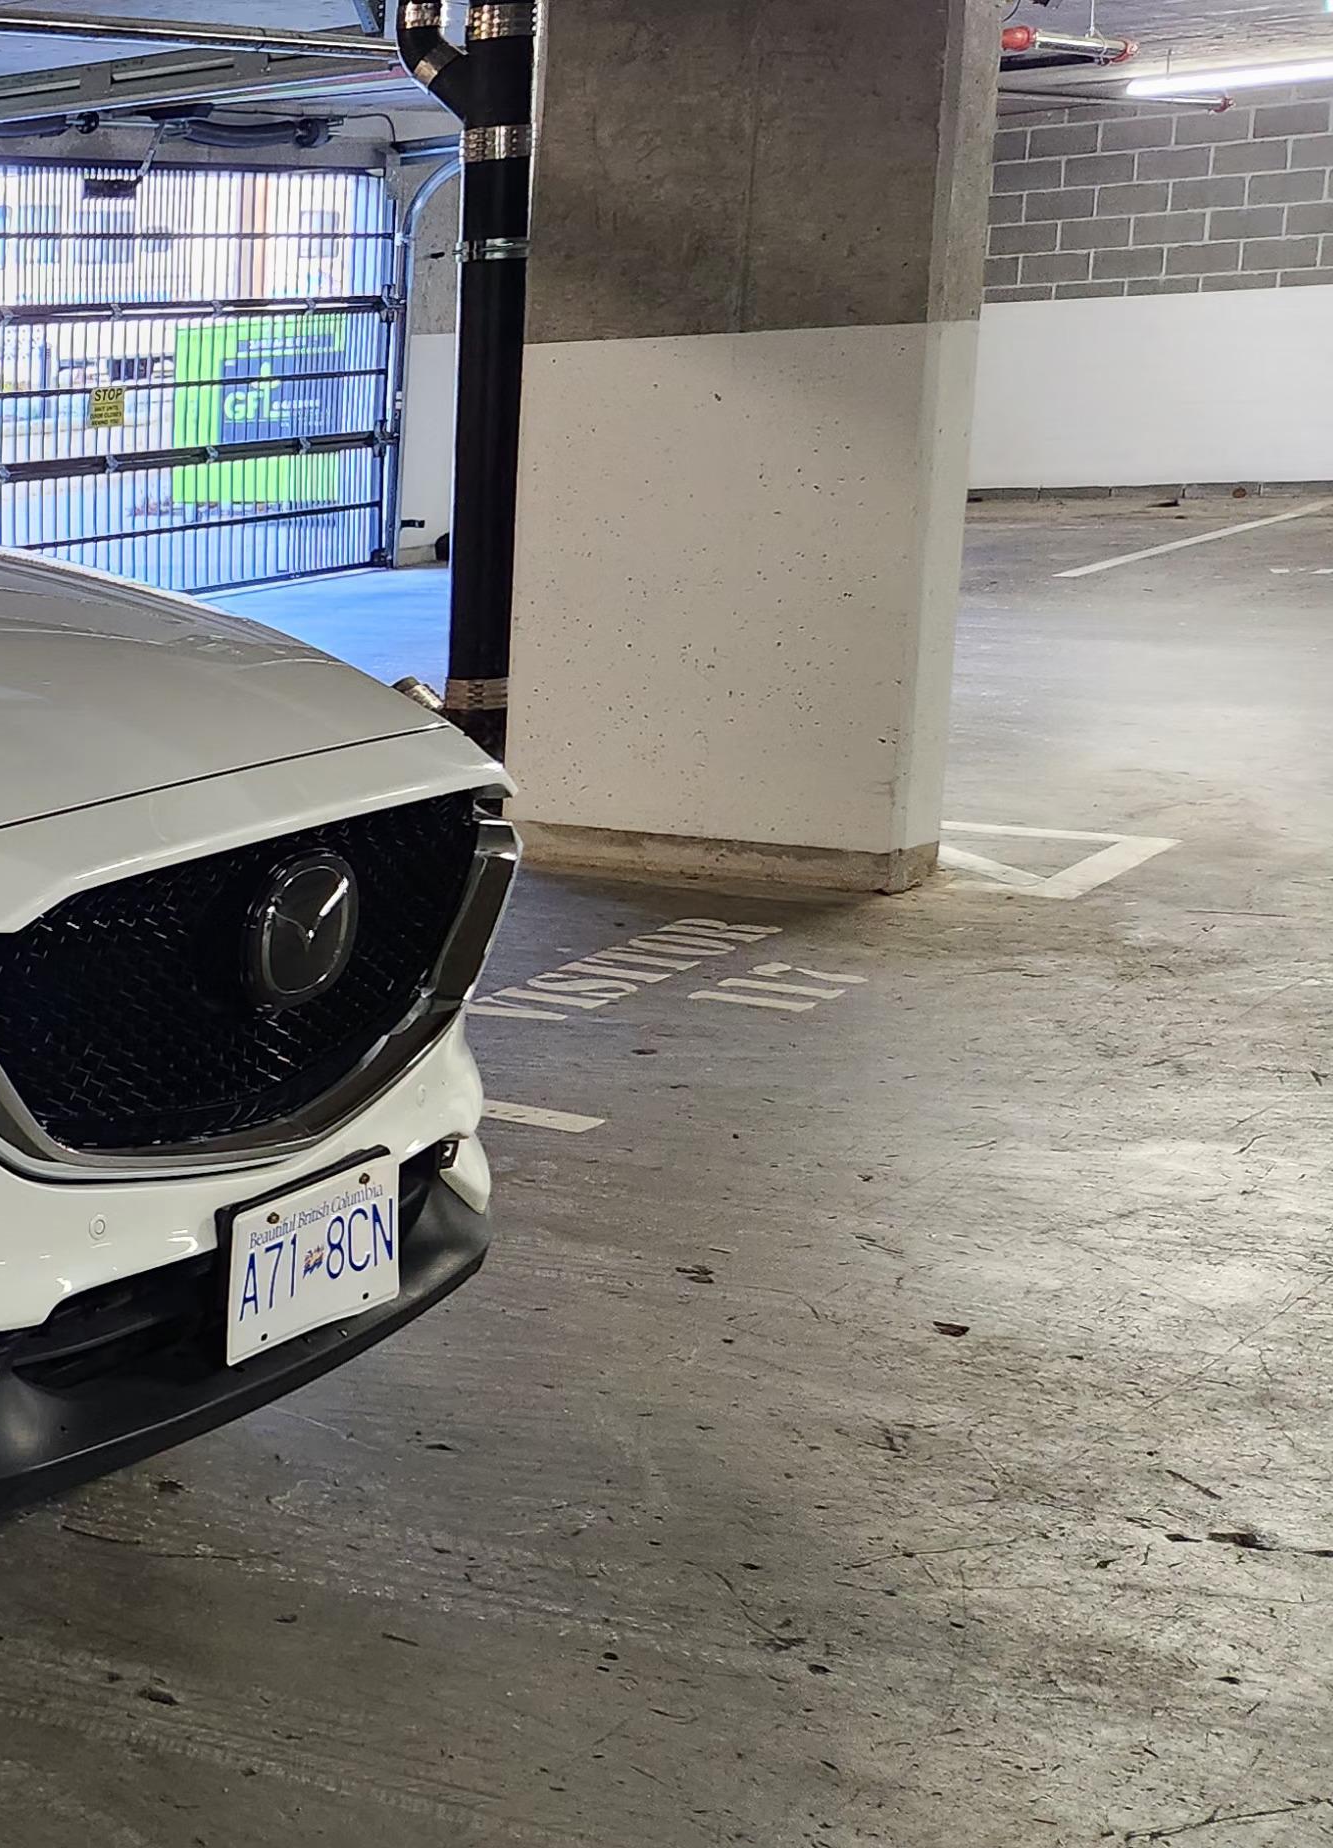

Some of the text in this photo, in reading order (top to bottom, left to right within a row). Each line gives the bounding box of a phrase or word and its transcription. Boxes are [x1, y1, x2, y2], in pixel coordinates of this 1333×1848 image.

[94, 387, 123, 401] STOP
[465, 917, 783, 1021] VISITOR
[248, 1182, 383, 1249] Beautiful British Columbia
[239, 1197, 394, 1322] A71 8CN
